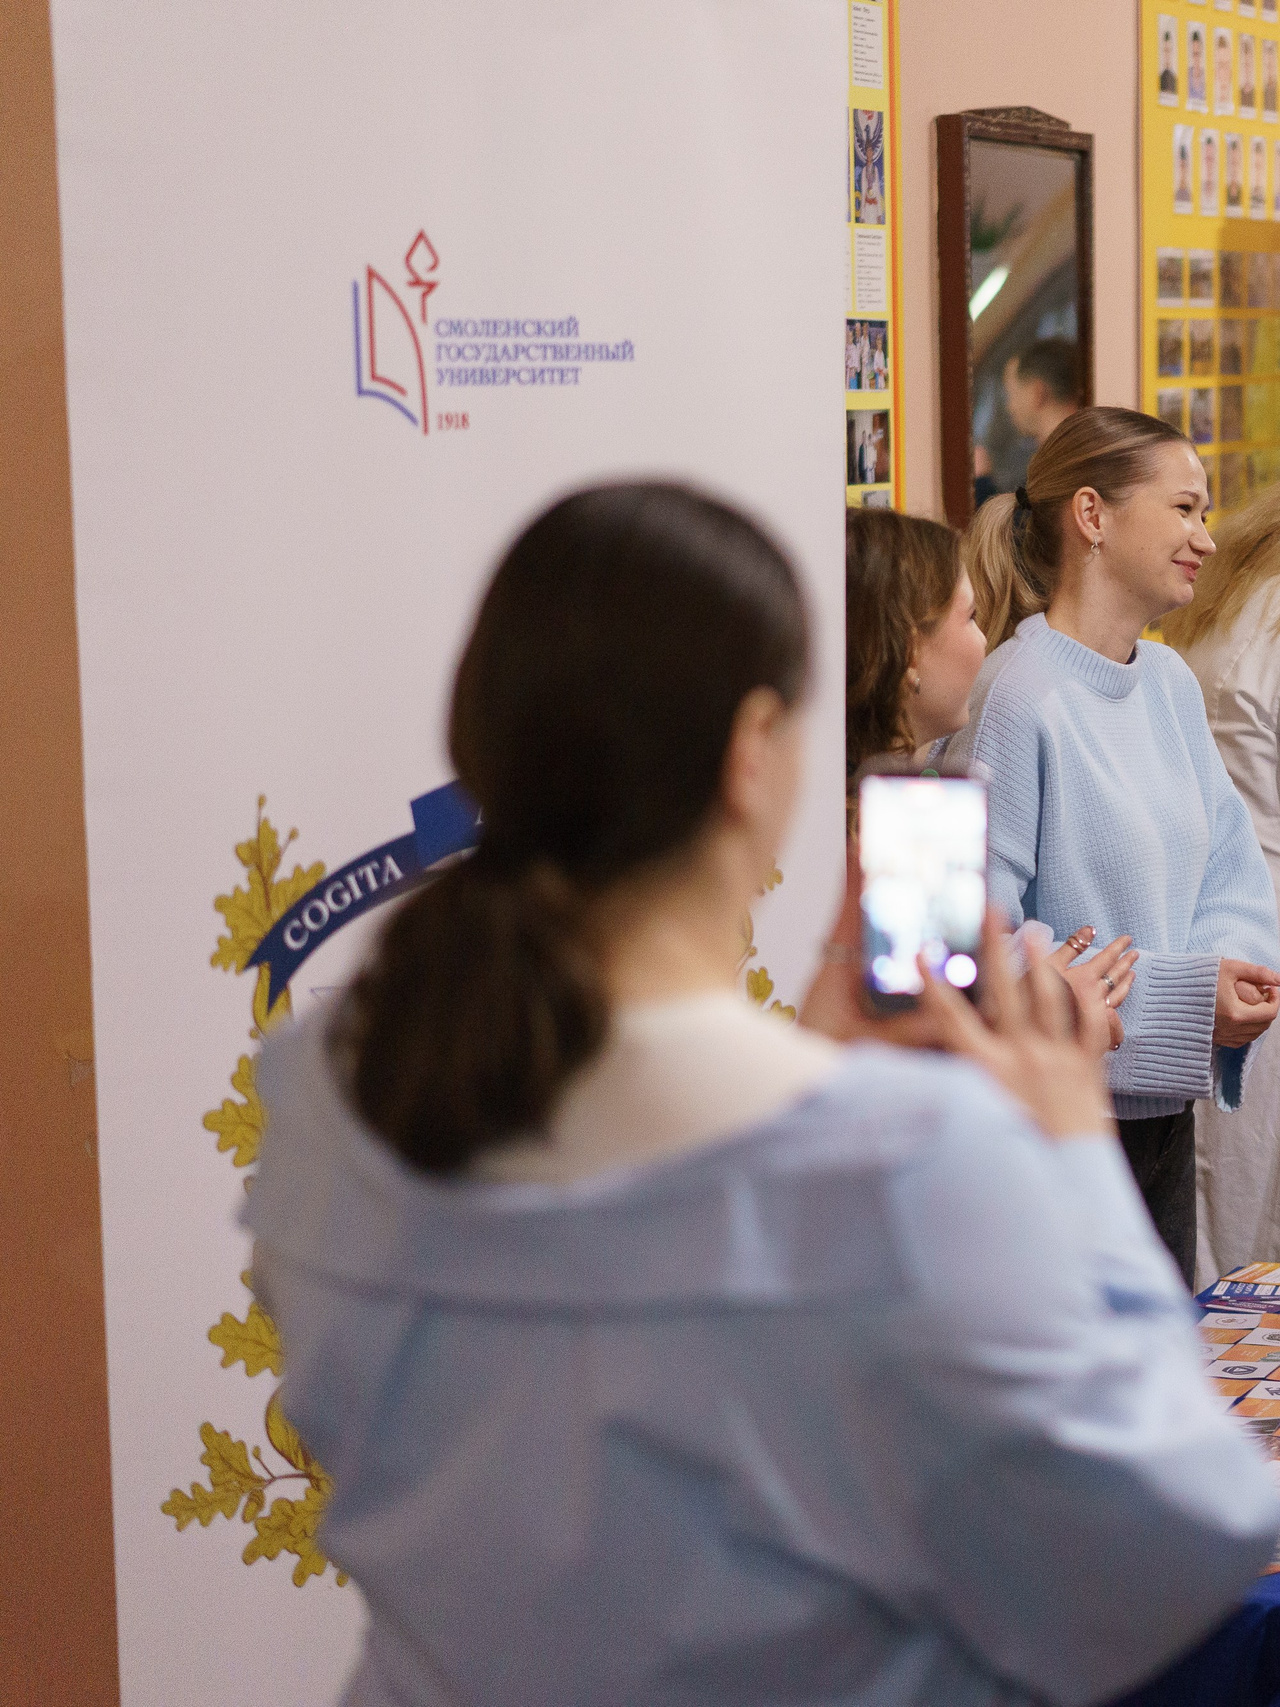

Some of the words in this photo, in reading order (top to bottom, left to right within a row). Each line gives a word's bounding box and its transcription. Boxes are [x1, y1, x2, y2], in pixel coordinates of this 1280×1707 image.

[433, 315, 580, 339] СМОЛЕНСКИЙ
[434, 339, 635, 363] ГОСУДАРСТВЕННЫЙ
[435, 366, 582, 387] УНИВЕРСИТЕТ
[437, 412, 470, 430] 1918
[282, 854, 403, 951] COGITA
